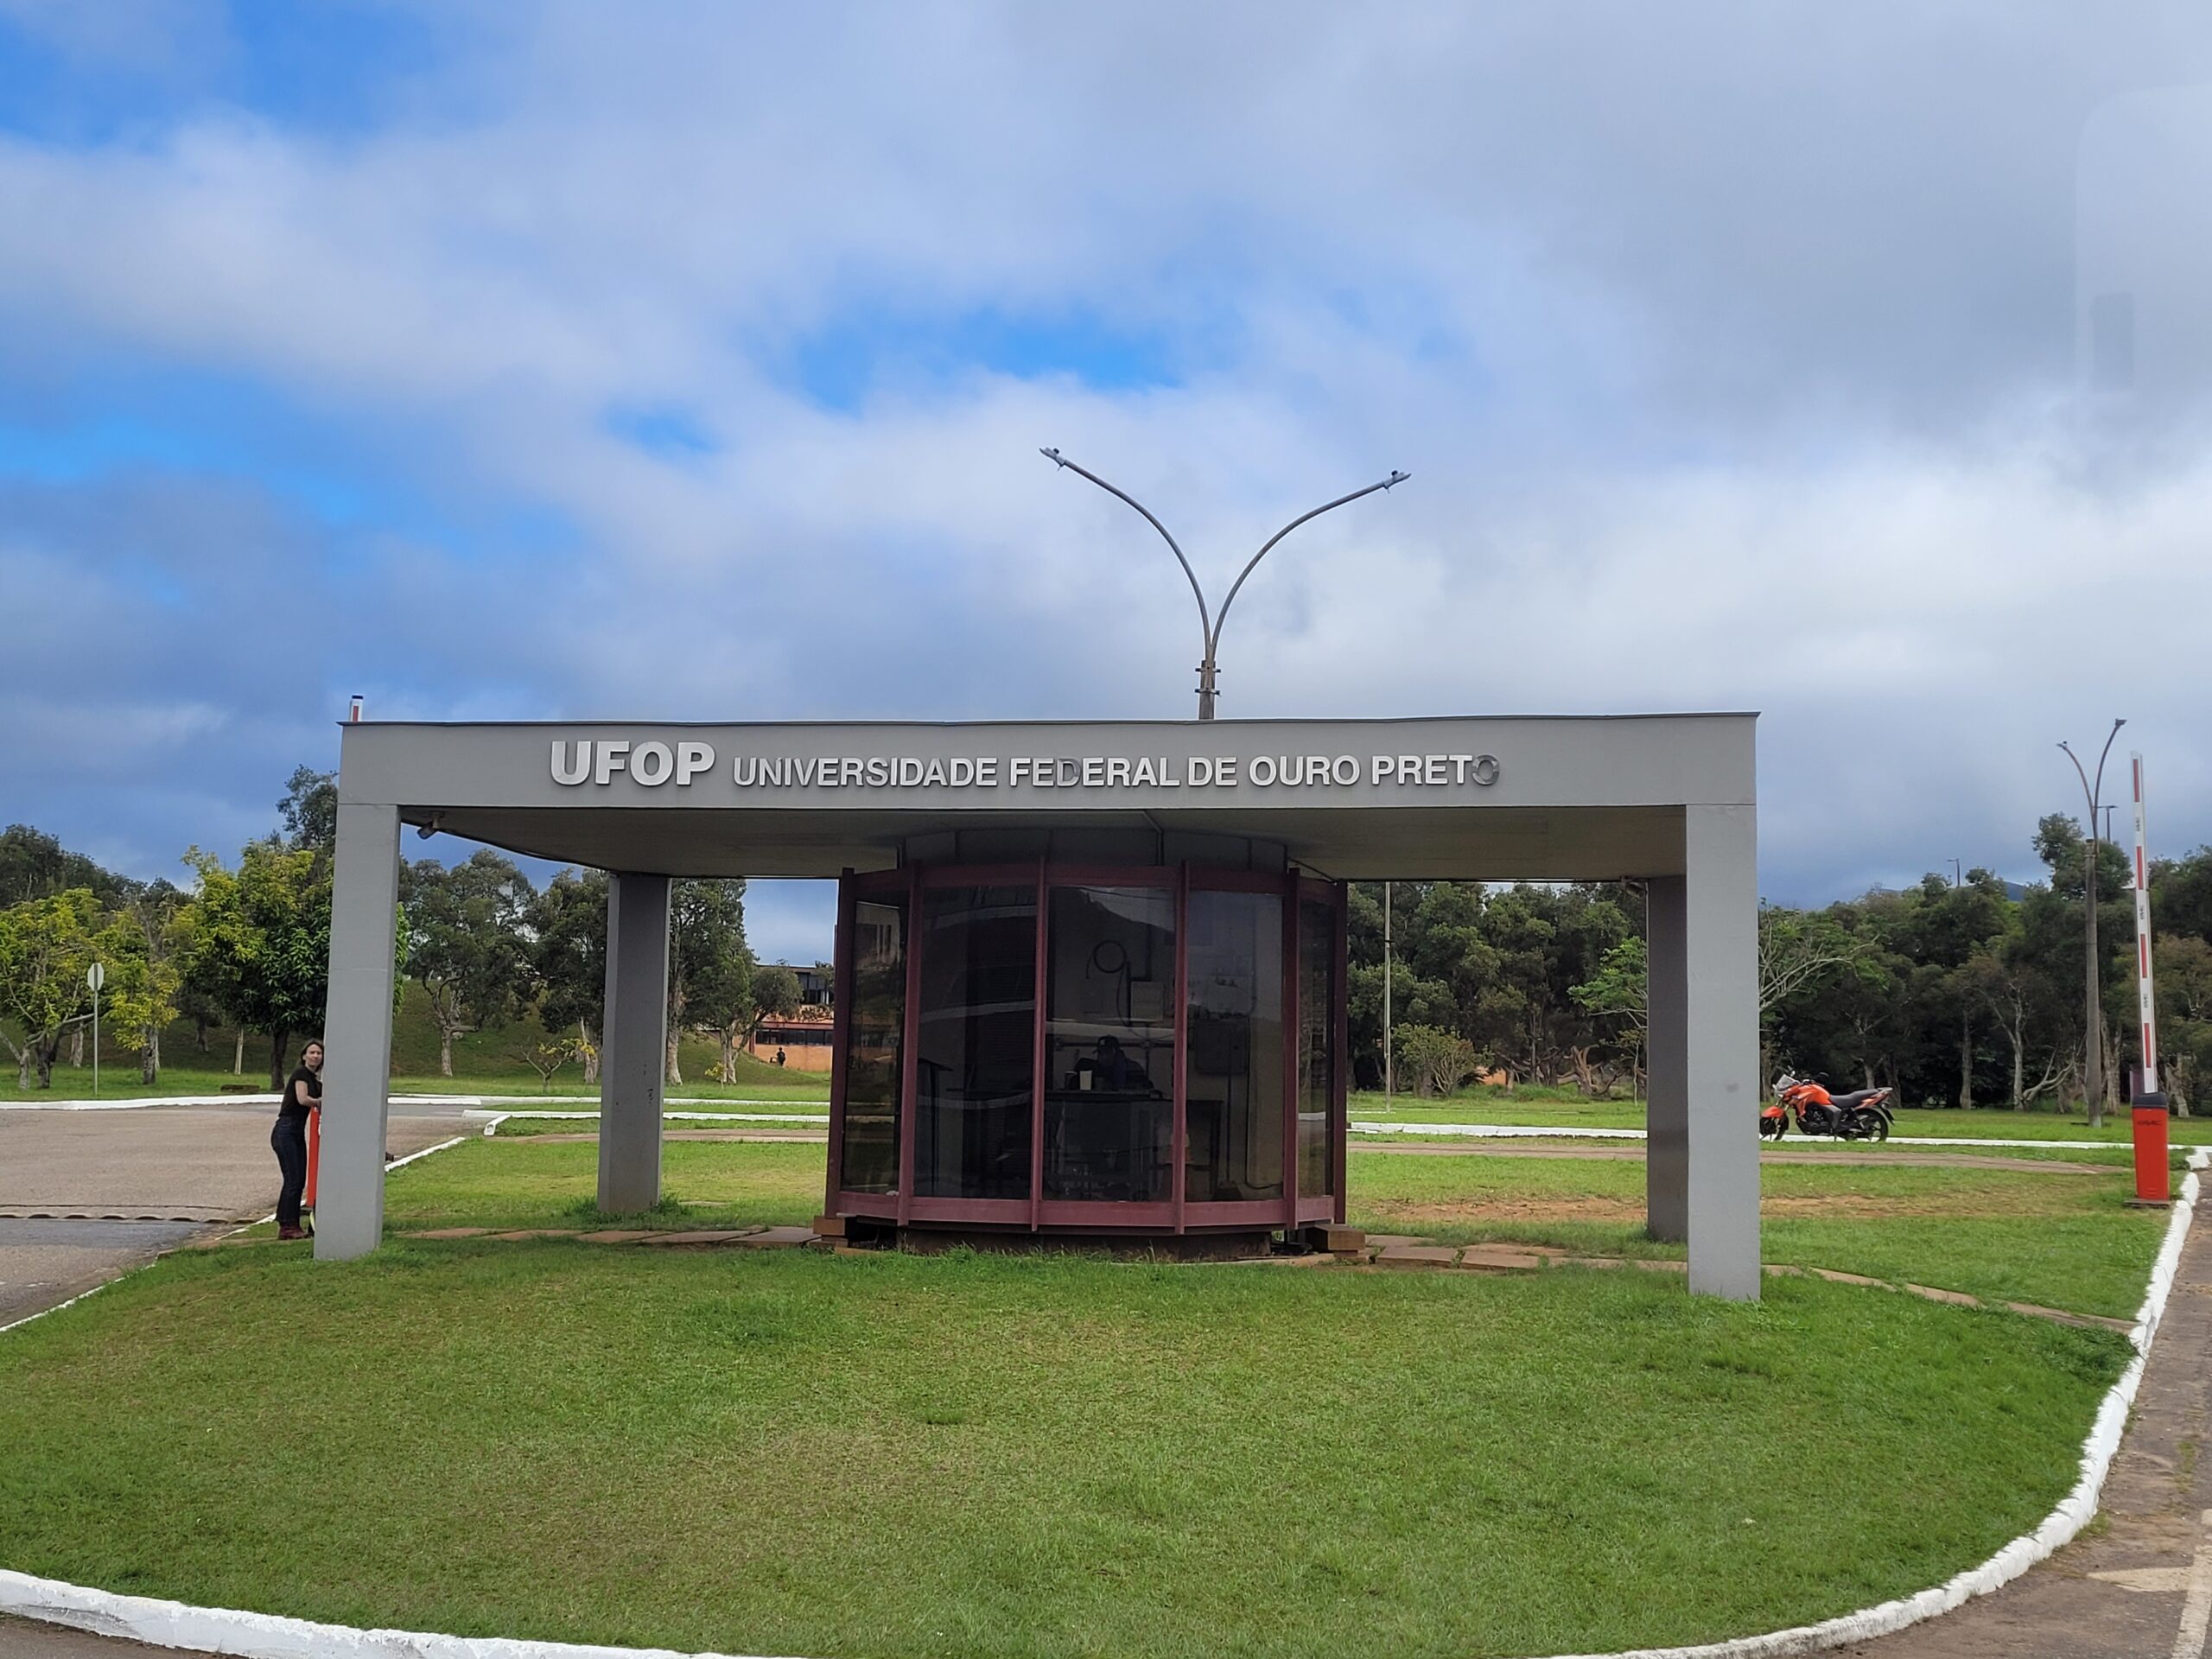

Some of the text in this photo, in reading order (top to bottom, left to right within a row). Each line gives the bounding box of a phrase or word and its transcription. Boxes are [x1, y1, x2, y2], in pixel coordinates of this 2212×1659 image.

[550, 741, 716, 786] UFOP
[733, 753, 1500, 788] UNIVERSIDADE FEDERAL DE OURO PRETO
